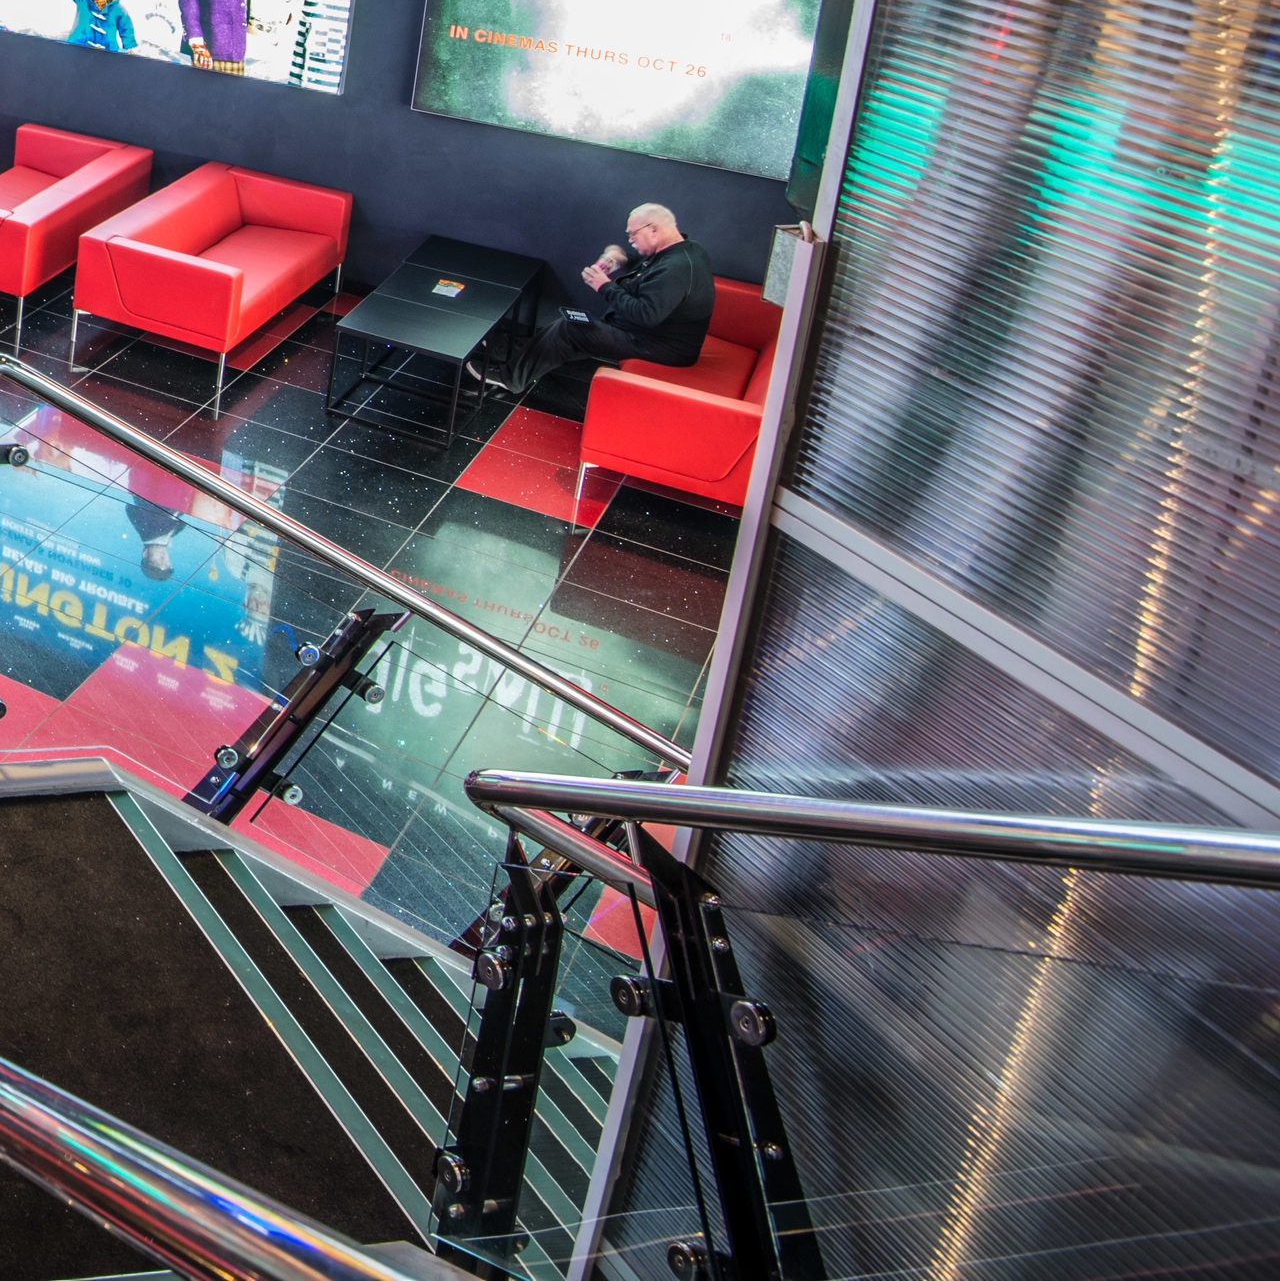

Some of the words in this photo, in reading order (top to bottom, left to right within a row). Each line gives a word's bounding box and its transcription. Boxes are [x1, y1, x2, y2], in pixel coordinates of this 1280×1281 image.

[449, 25, 469, 41] IN
[474, 29, 559, 54] CINEMAS
[565, 44, 630, 66] THURS
[638, 57, 679, 74] OCT
[686, 63, 708, 79] 26
